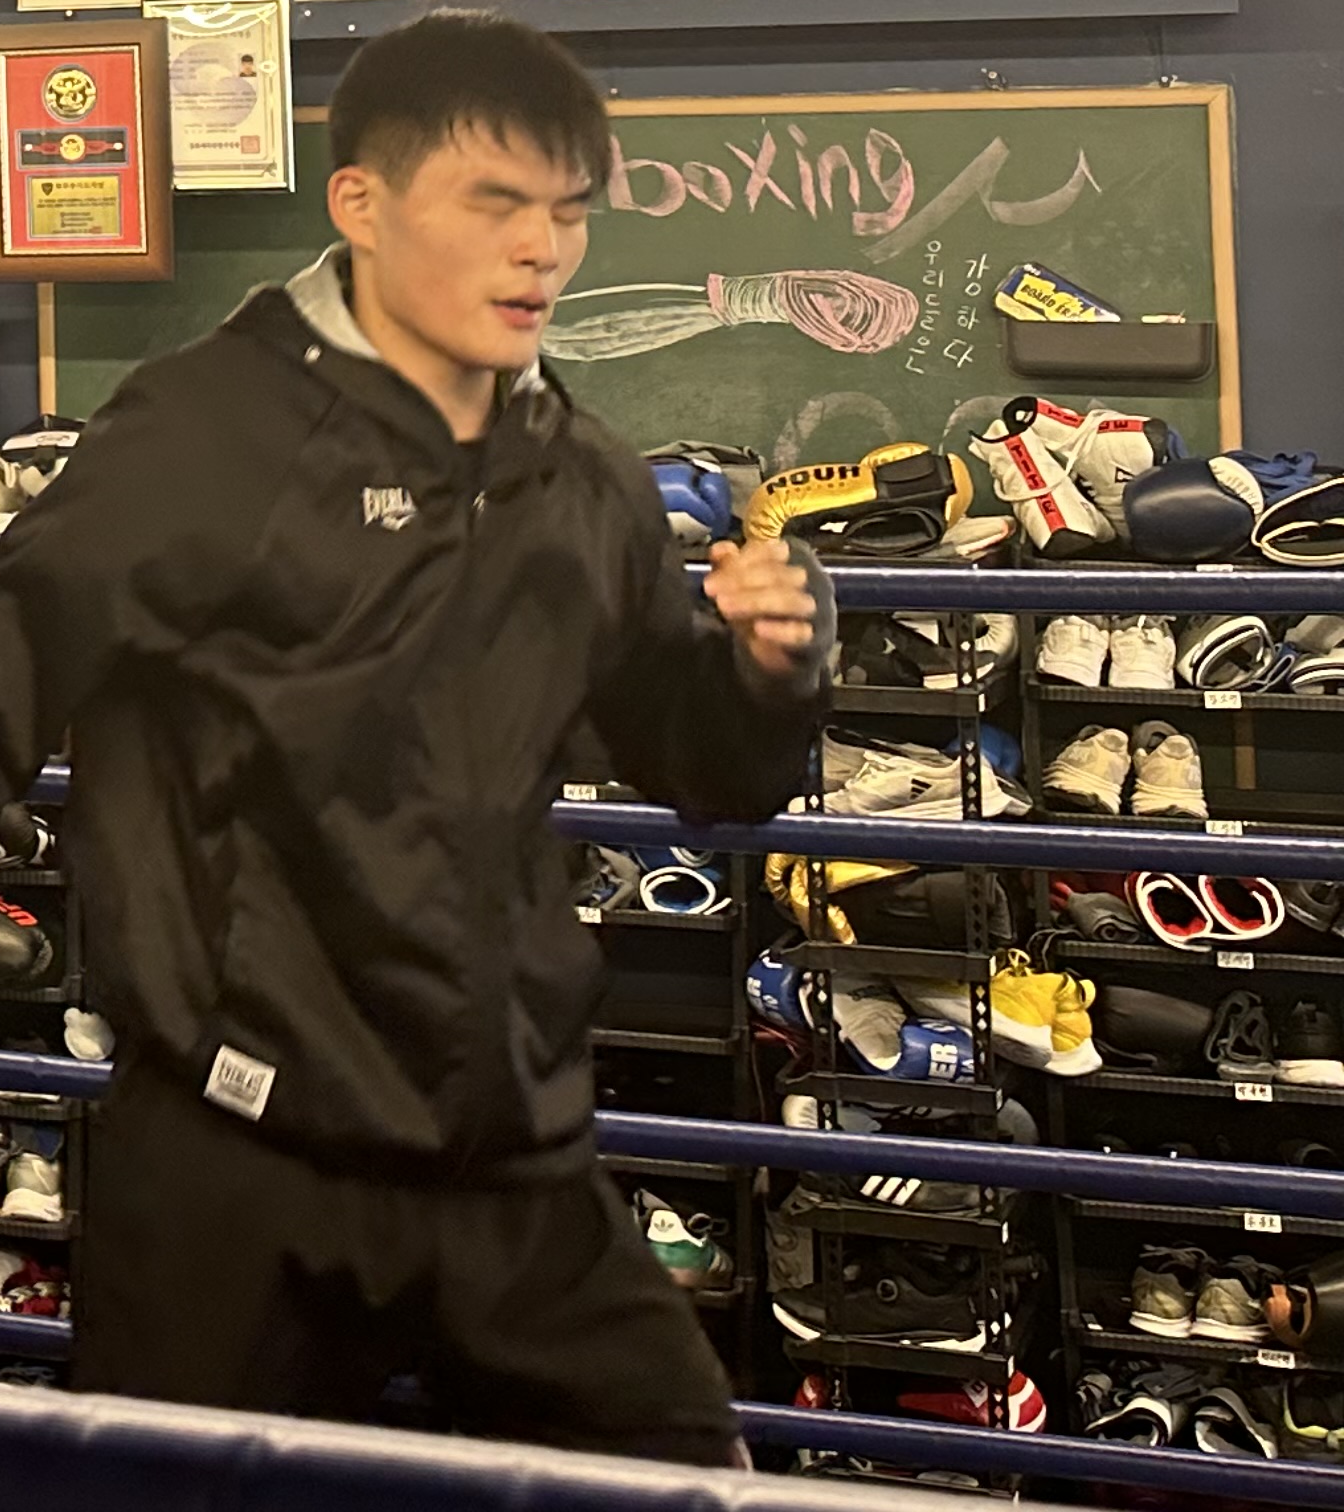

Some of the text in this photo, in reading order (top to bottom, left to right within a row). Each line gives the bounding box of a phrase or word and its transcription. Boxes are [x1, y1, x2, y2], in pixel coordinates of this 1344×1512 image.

[905, 240, 944, 375] 우리들은
[943, 253, 990, 369] 강하다
[1020, 283, 1056, 307] BOARD
[1009, 444, 1057, 515] TITE
